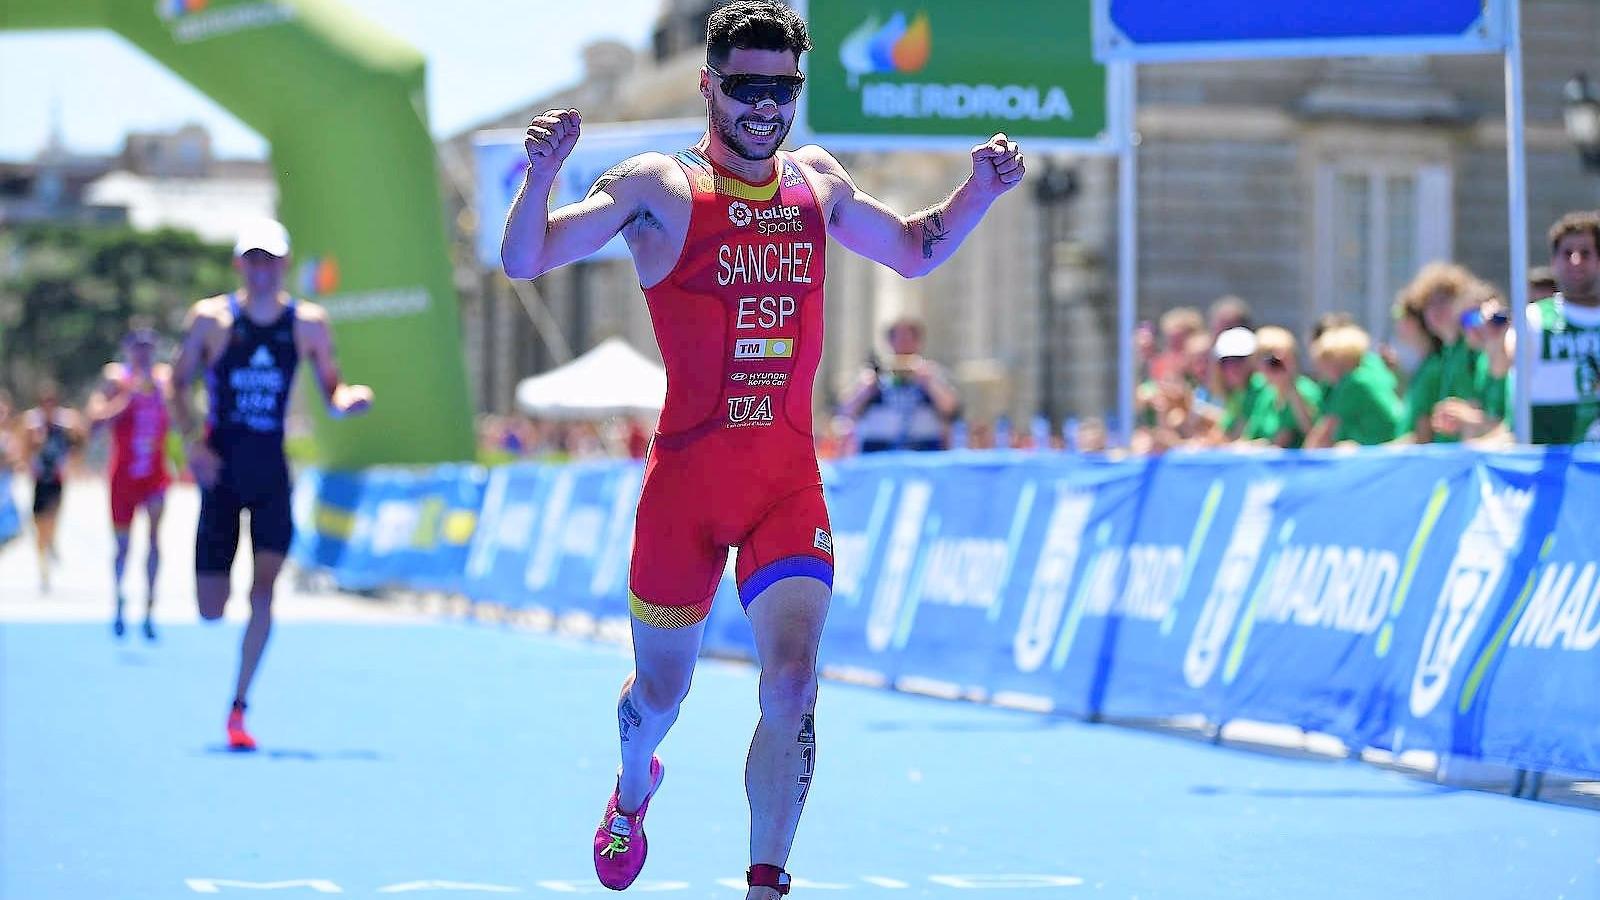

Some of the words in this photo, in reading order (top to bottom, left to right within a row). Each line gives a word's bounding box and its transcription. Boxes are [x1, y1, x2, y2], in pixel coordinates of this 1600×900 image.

[862, 83, 1073, 120] IBERDROLA
[754, 204, 800, 220] LaLiga
[757, 218, 803, 236] Sports
[717, 243, 813, 285] SANCHEZ
[736, 296, 796, 329] ESP
[739, 343, 760, 354] TM
[728, 395, 773, 422] UA
